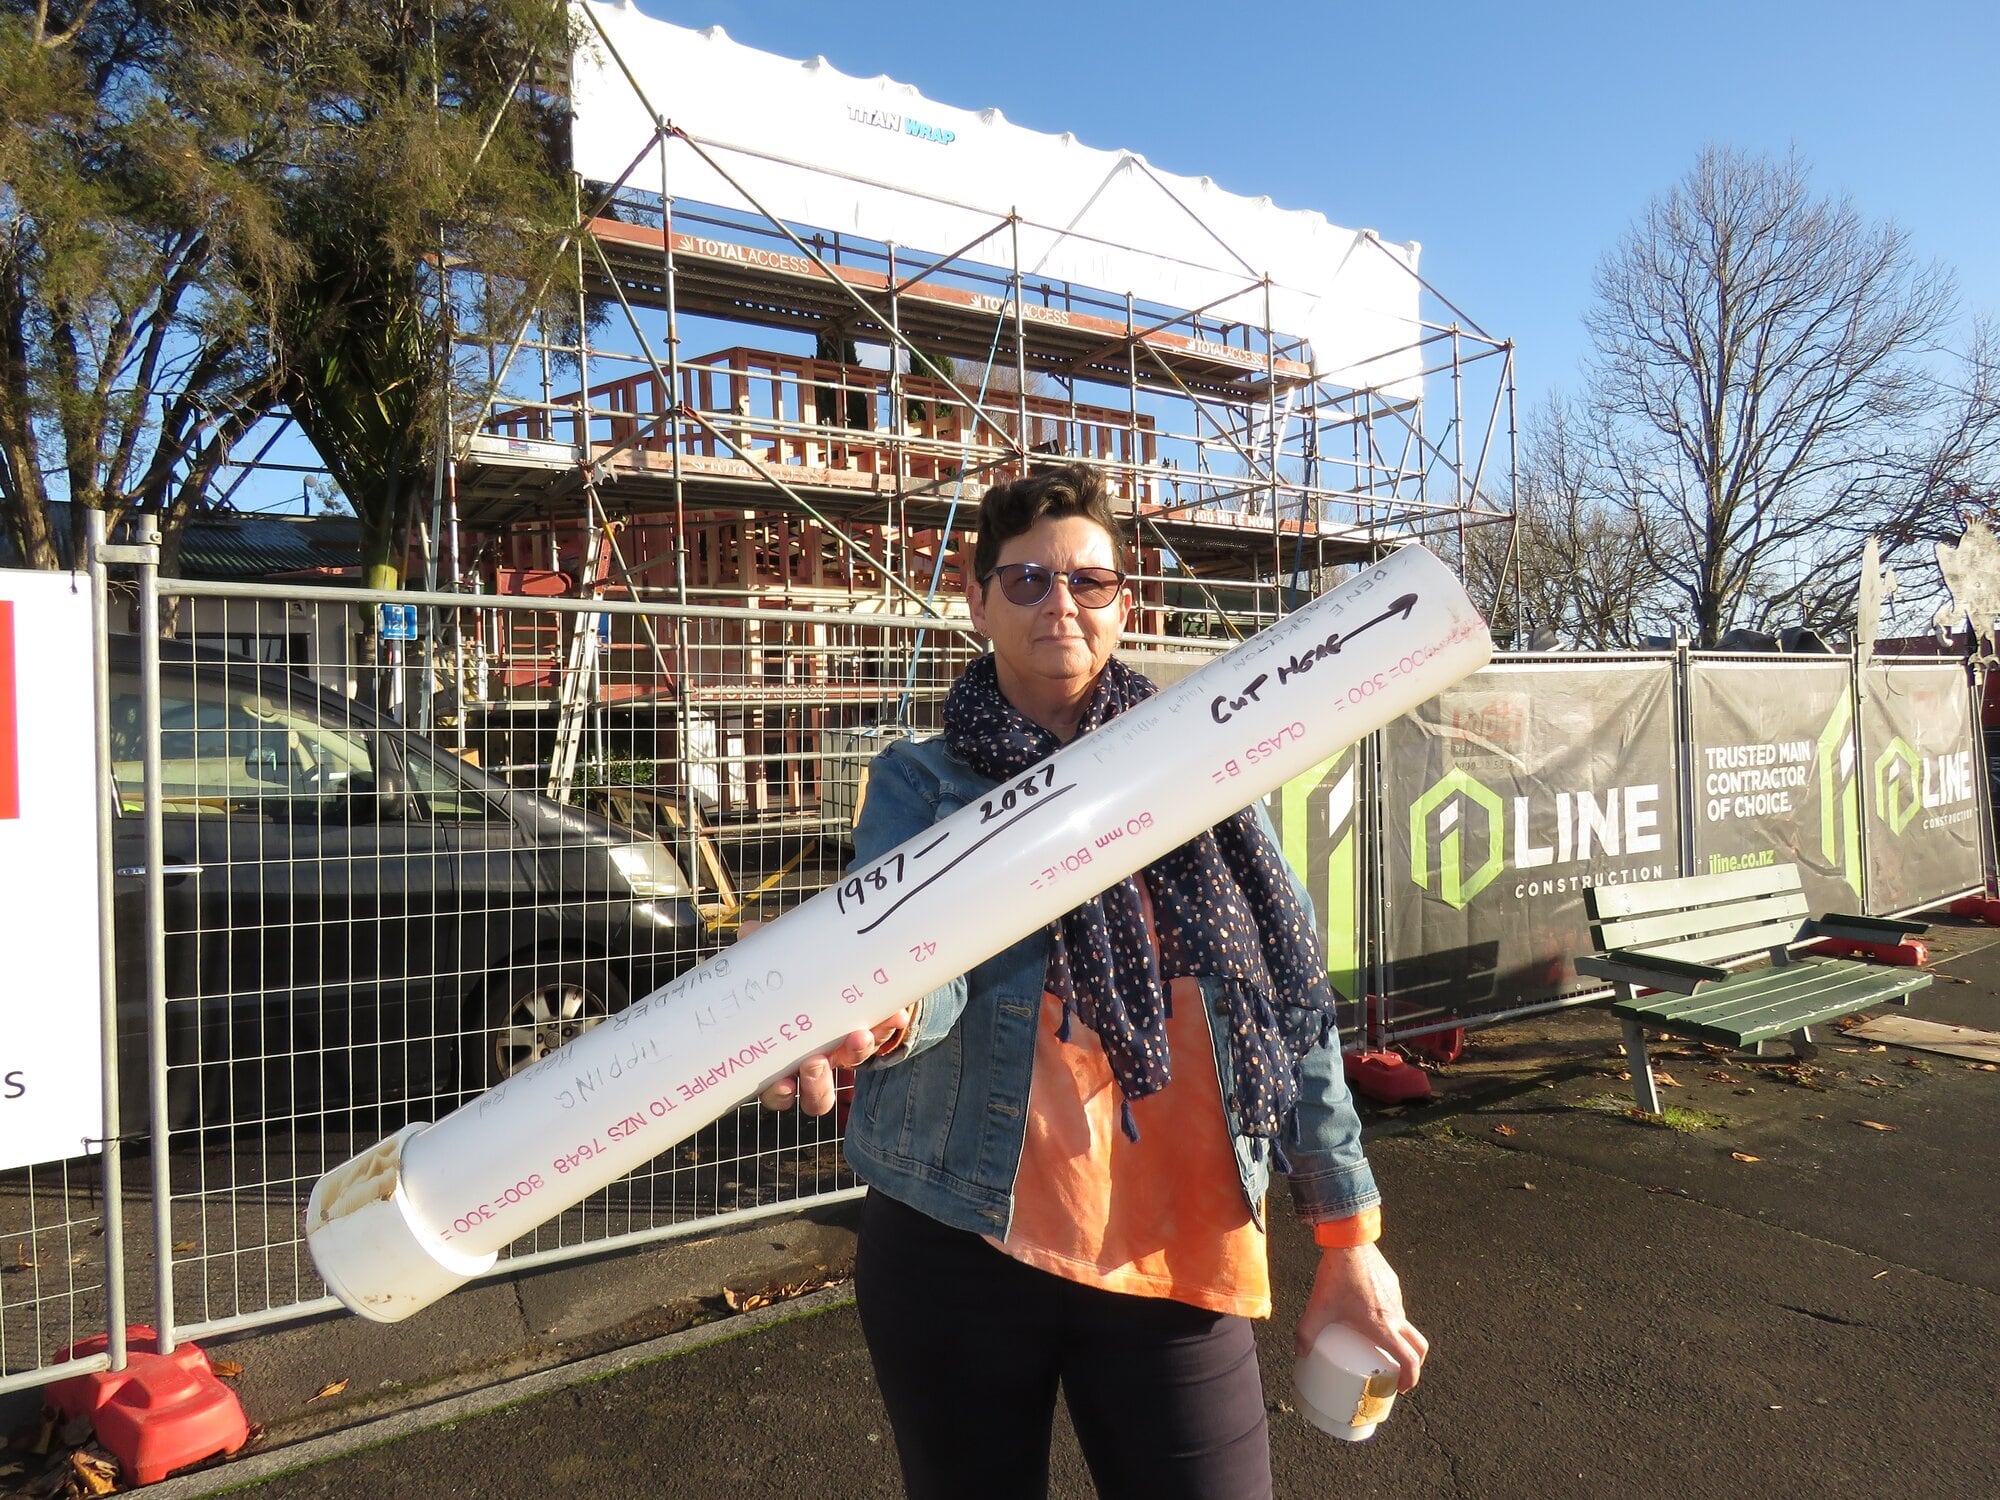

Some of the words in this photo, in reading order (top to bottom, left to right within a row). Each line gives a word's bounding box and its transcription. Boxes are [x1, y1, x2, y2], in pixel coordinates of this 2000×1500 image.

[846, 103, 901, 132] TITAN
[904, 116, 956, 145] WRAP
[1244, 721, 1305, 764] CLASS
[1705, 744, 1777, 769] TRUSTED
[1778, 741, 1811, 763] MAIN
[1706, 766, 1806, 796] CONTRACTOR
[1922, 750, 1972, 808] LINE
[1707, 798, 1731, 821] OF
[1734, 791, 1792, 818] CHOICE.
[836, 852, 904, 914] 1987
[979, 762, 1055, 824] 2087
[1094, 826, 1124, 848] mm
[1125, 811, 1154, 835] 80
[1514, 784, 1661, 868] LINE
[1708, 850, 1776, 875] iline.co.nz
[1515, 865, 1663, 899] CONSTRUCTION
[908, 941, 937, 962] 42
[872, 967, 889, 985] D
[648, 1095, 678, 1117] TO
[606, 1111, 648, 1142] NZS
[552, 1137, 607, 1174] 7648
